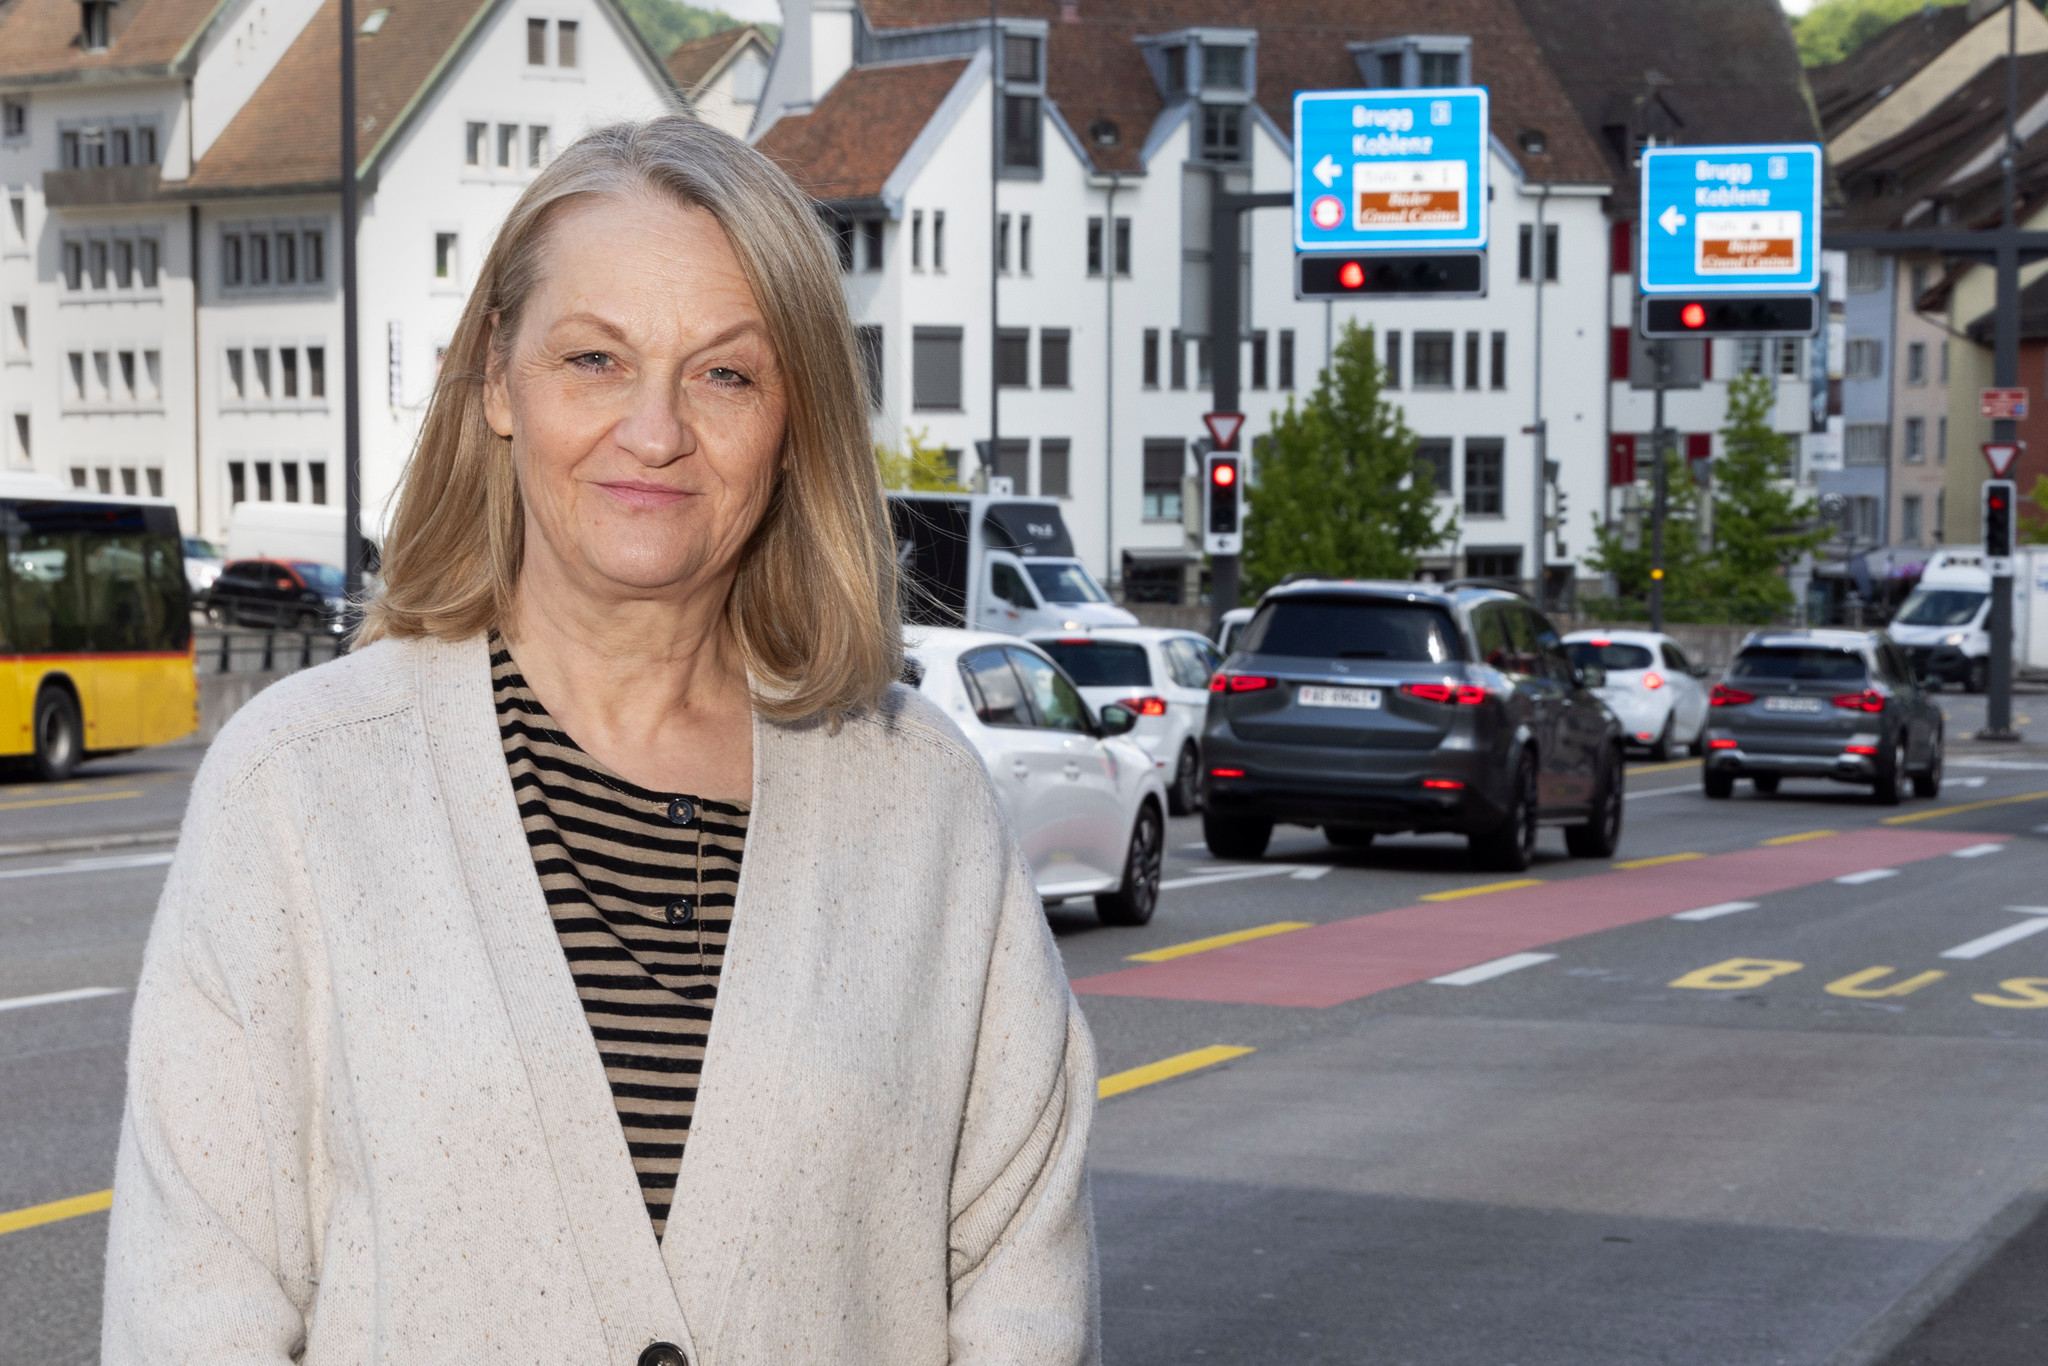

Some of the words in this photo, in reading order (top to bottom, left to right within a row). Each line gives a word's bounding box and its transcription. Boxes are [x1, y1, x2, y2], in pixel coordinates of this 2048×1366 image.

[1353, 105, 1413, 131] Brugg
[1353, 133, 1433, 155] Koblenz
[1696, 160, 1752, 184] Brugg
[1696, 186, 1770, 206] Koblenz
[1668, 957, 2048, 1008] BUS
